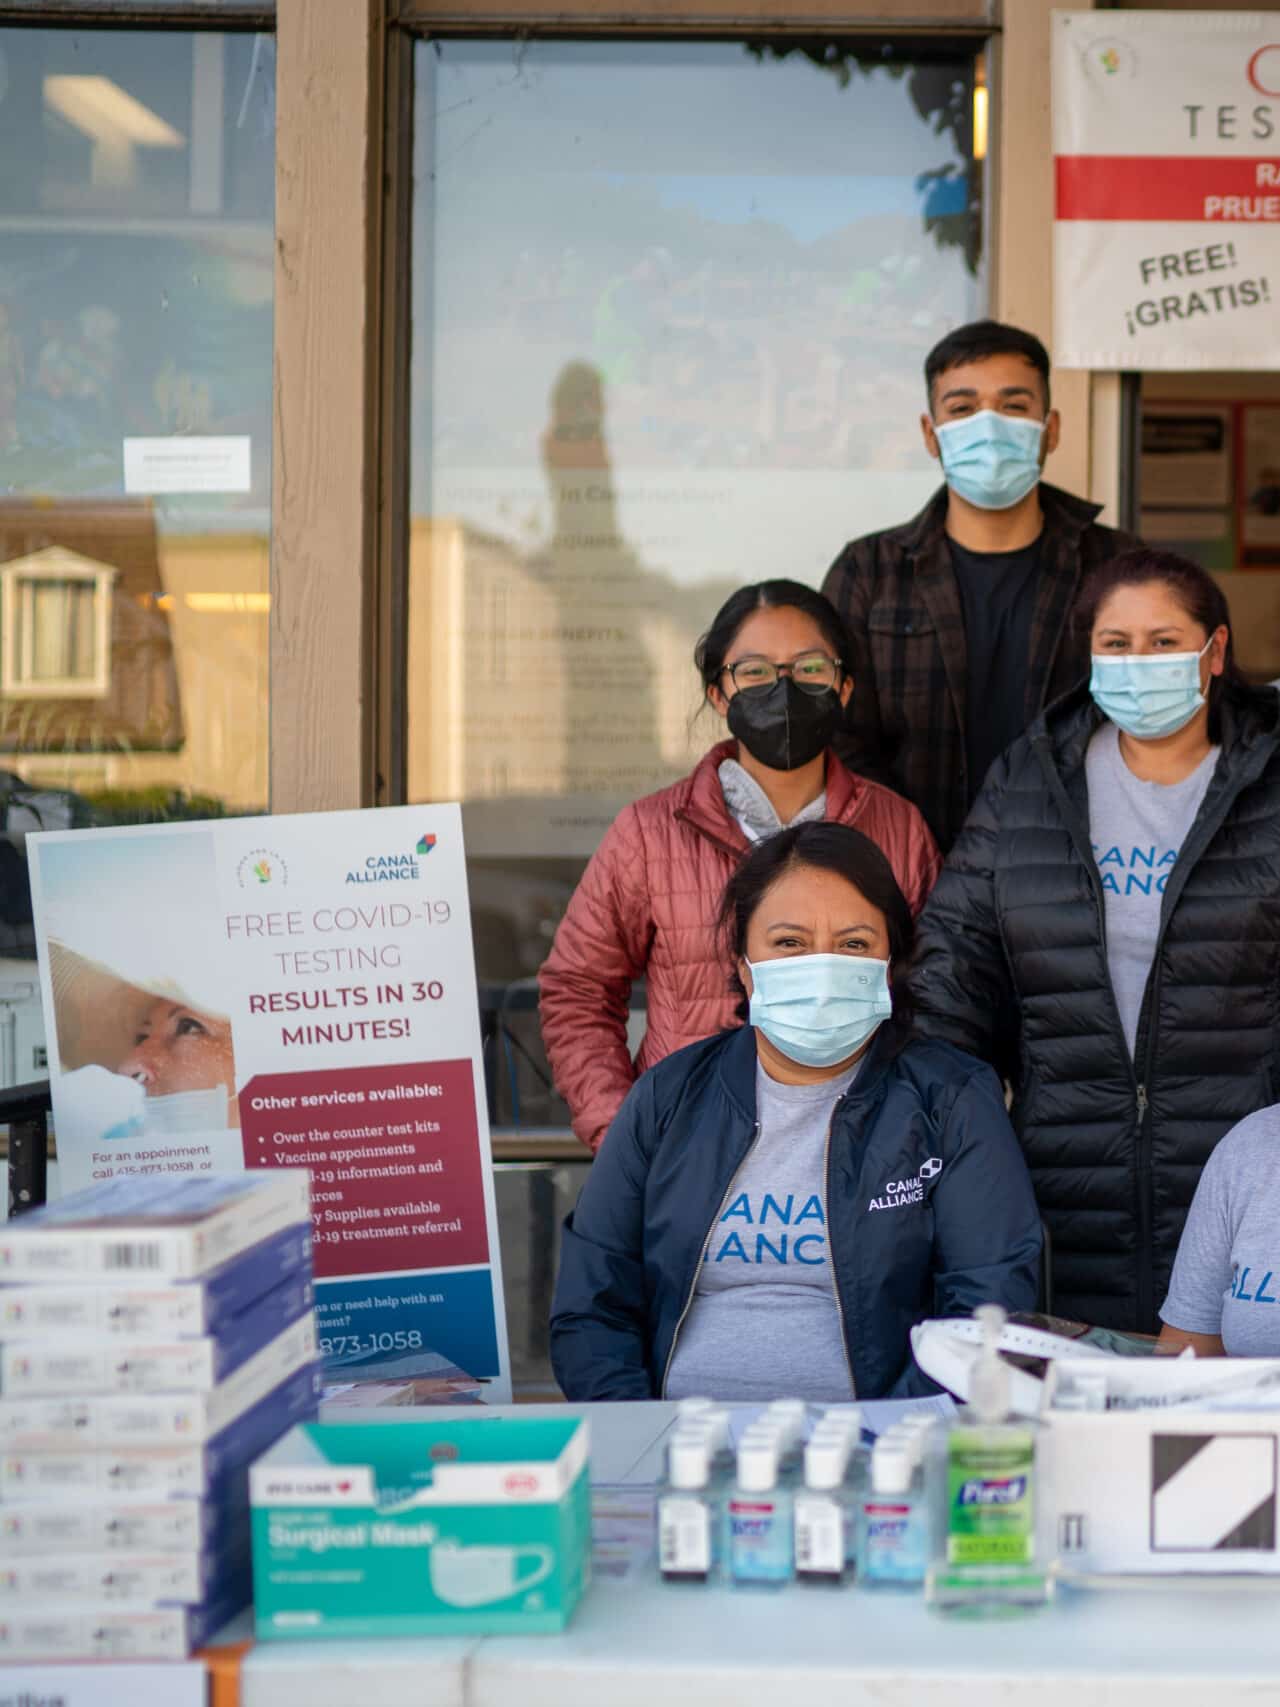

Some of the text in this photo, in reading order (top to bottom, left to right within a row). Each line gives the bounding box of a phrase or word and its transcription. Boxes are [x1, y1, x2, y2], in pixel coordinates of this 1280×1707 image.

[1139, 242, 1238, 285] FREE!
[1125, 278, 1271, 336] ¡GRATIS!
[366, 855, 418, 869] CANAL
[1091, 845, 1178, 868] ANA
[345, 867, 419, 884] ALLIANCE
[226, 900, 451, 939] FREE COVID-19
[273, 944, 401, 975] TESTING
[249, 980, 444, 1013] RESULTS IN 30
[281, 1018, 411, 1046] MINUTES!
[251, 1084, 443, 1111] Other services available:
[273, 1120, 440, 1144] Over the counter test kits
[92, 1152, 113, 1164] For
[115, 1152, 131, 1161] an
[275, 1149, 327, 1165] Vaccine
[92, 1168, 114, 1179] call
[199, 1161, 212, 1170] or
[337, 1162, 417, 1180] information
[418, 1159, 443, 1173] and
[886, 1176, 923, 1194] CANAL
[868, 1188, 923, 1212] ALLIANCE
[324, 1206, 381, 1224] Supplies
[383, 1201, 441, 1217] available
[342, 1224, 409, 1240] treatment
[412, 1218, 462, 1233] referral
[703, 1231, 828, 1266] ANC
[330, 1302, 343, 1311] or
[345, 1297, 373, 1310] need
[374, 1295, 399, 1309] help
[400, 1292, 427, 1306] with
[429, 1293, 444, 1303] an
[268, 1521, 436, 1553] Surgical Mask
